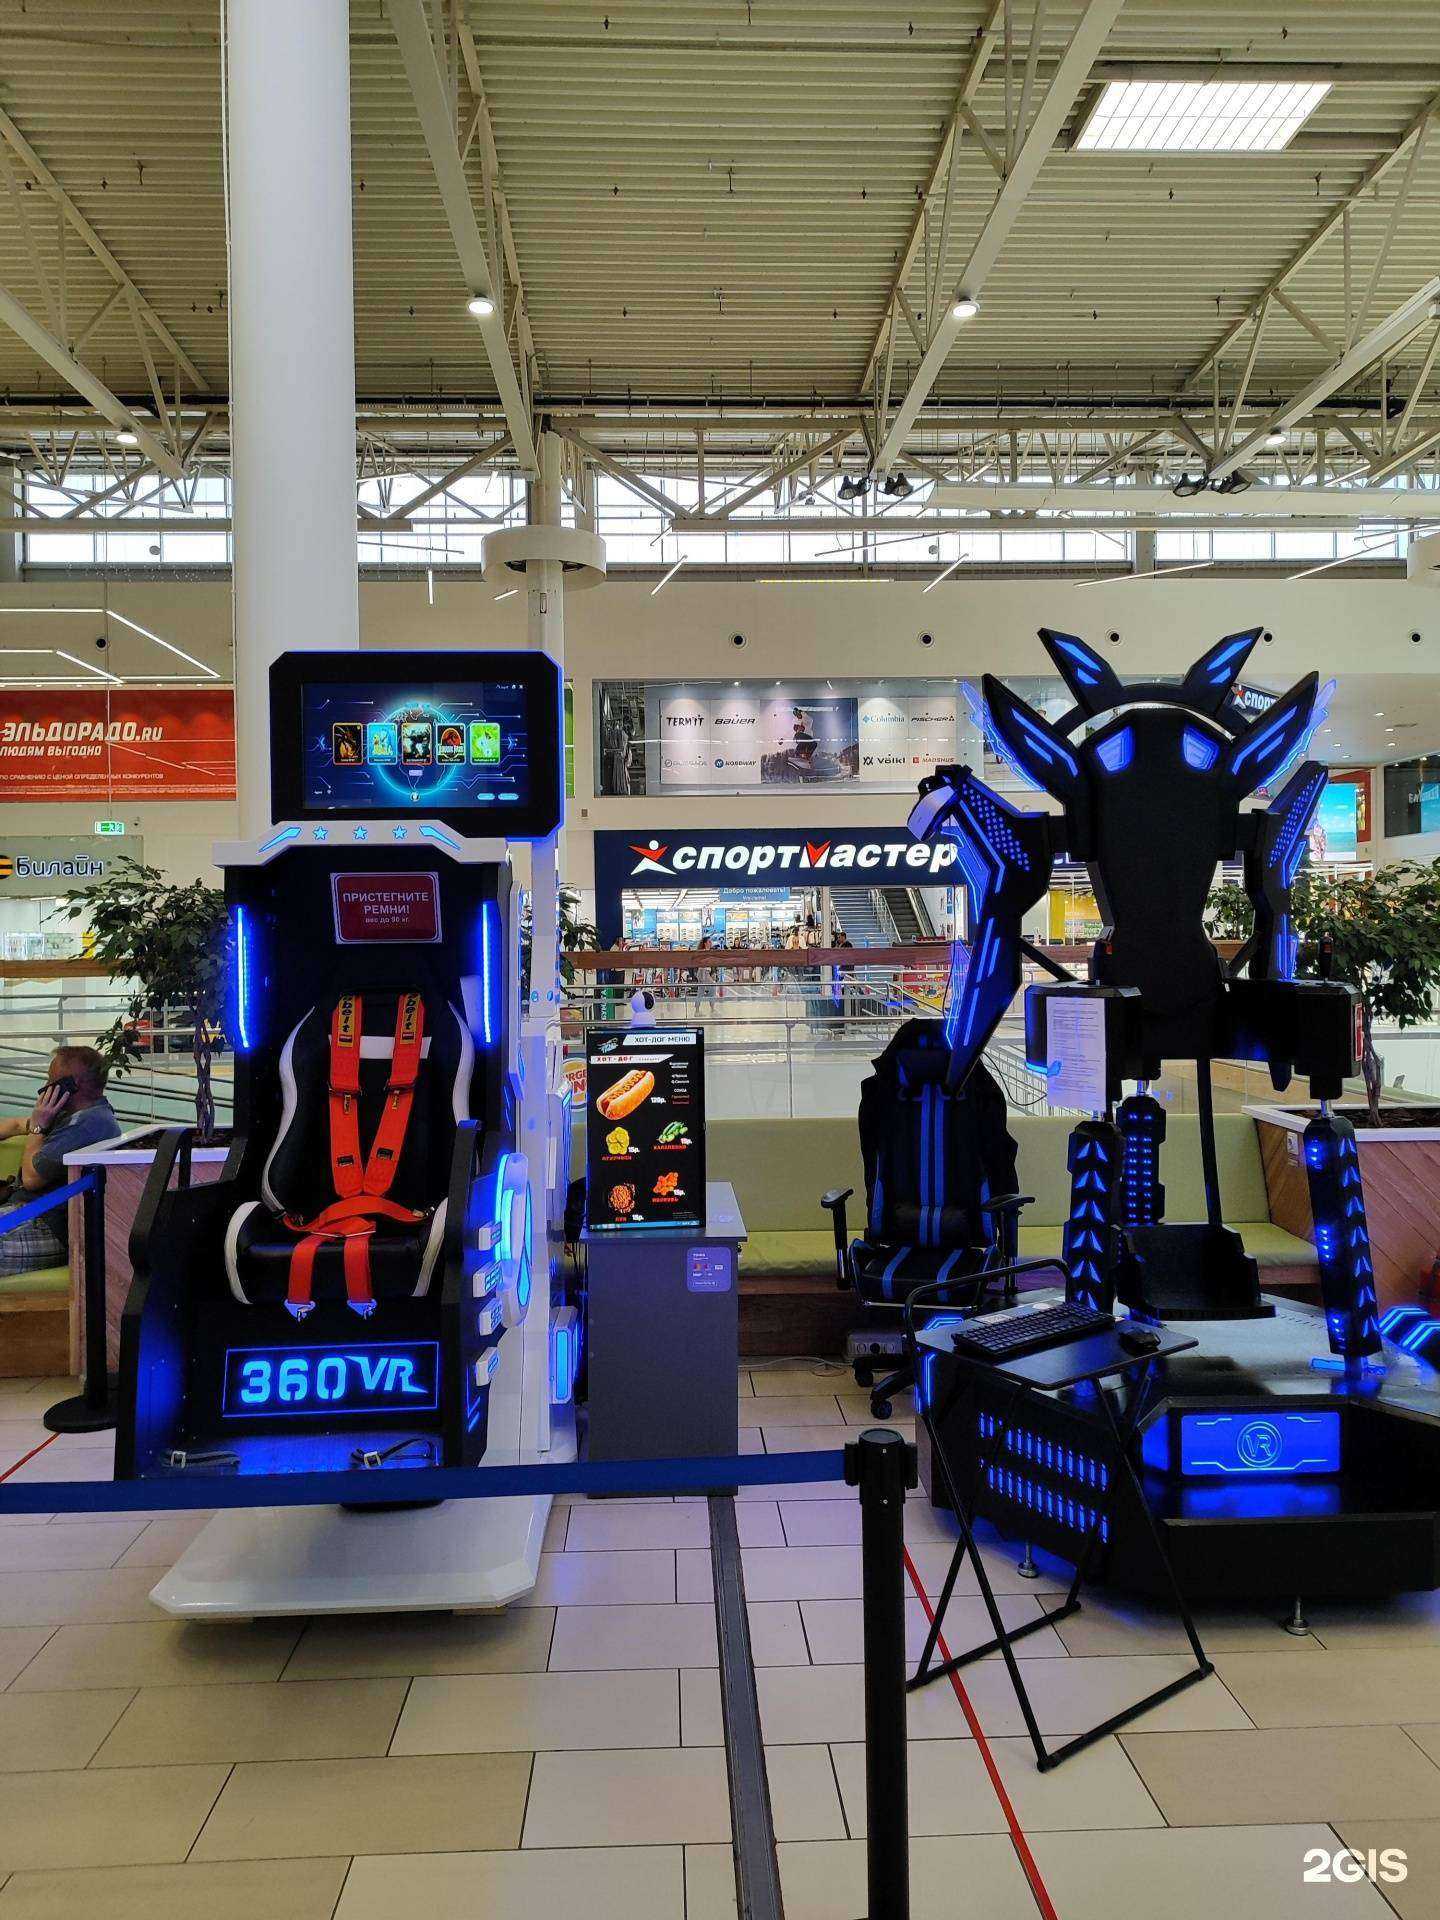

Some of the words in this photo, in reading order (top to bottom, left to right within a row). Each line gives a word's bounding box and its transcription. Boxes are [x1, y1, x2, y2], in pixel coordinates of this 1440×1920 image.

[1, 722, 163, 741] ЭЛЬДОРАДО.RU
[47, 745, 102, 756] ВЫГОДНО
[343, 892, 430, 902] ПРИСТЕГНИТЕ
[364, 905, 410, 914] РЕМНИ!
